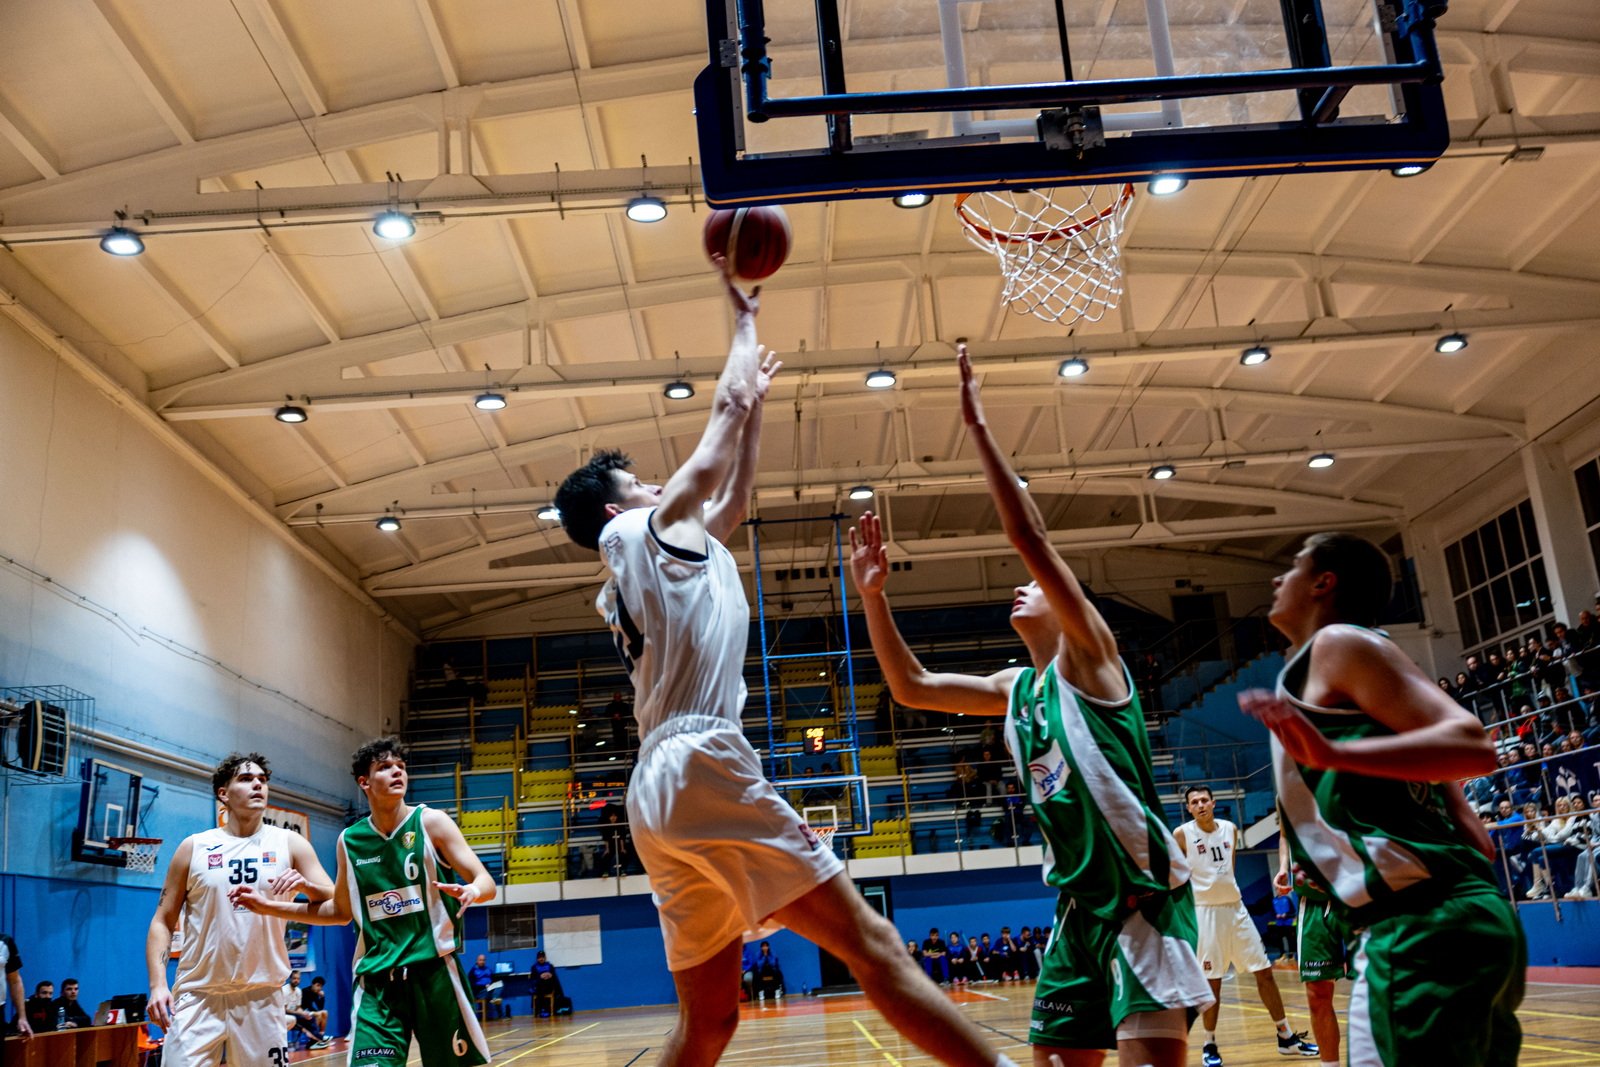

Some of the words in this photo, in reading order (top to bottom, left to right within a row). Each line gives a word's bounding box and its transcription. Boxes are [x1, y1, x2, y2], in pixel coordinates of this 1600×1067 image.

[813, 736, 823, 751] 5
[1211, 846, 1224, 862] 11
[228, 858, 258, 885] 35
[404, 852, 419, 880] 6
[368, 897, 391, 908] Exact
[385, 897, 421, 912] Systems
[452, 1028, 468, 1057] 6
[356, 1048, 396, 1059] ENKLAWA
